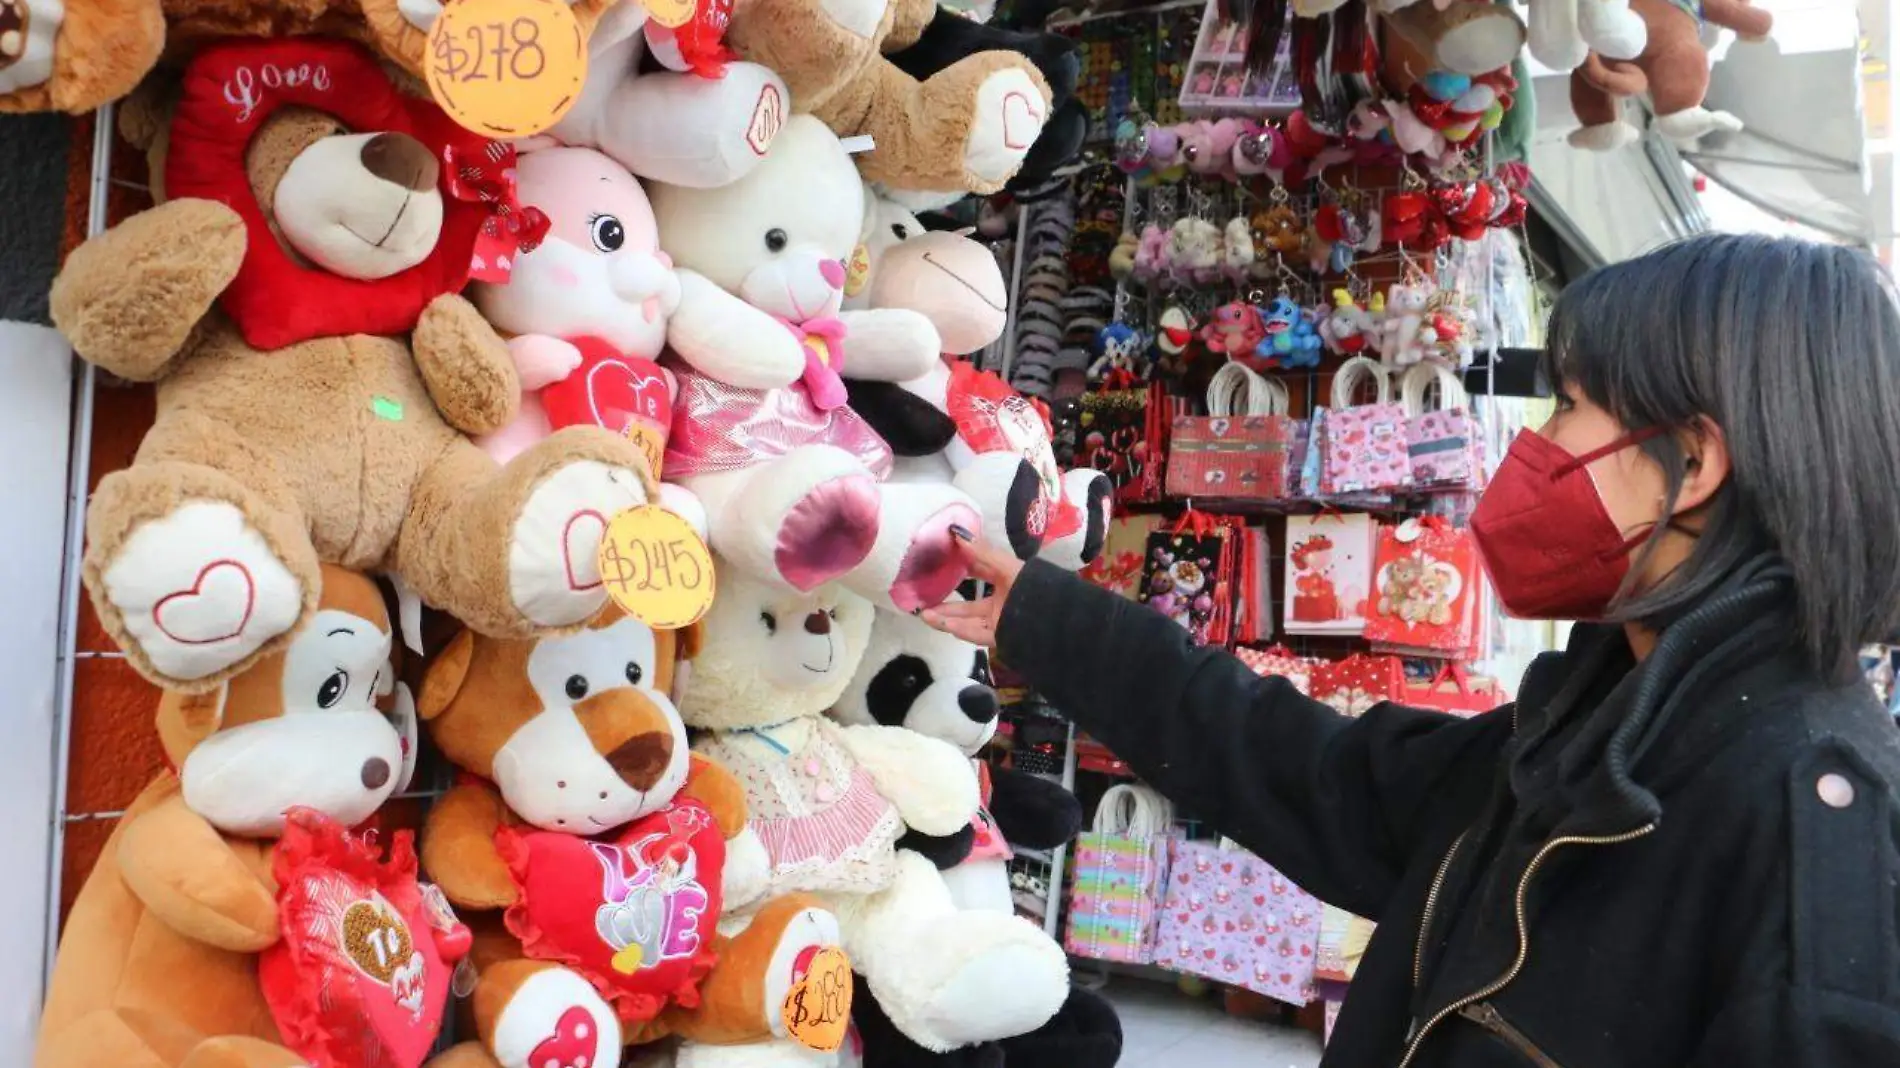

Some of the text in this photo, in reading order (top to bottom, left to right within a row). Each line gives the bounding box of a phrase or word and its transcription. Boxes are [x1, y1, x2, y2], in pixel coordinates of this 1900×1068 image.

[433, 16, 545, 83] $278
[223, 63, 330, 124] Love
[602, 537, 702, 594] $245
